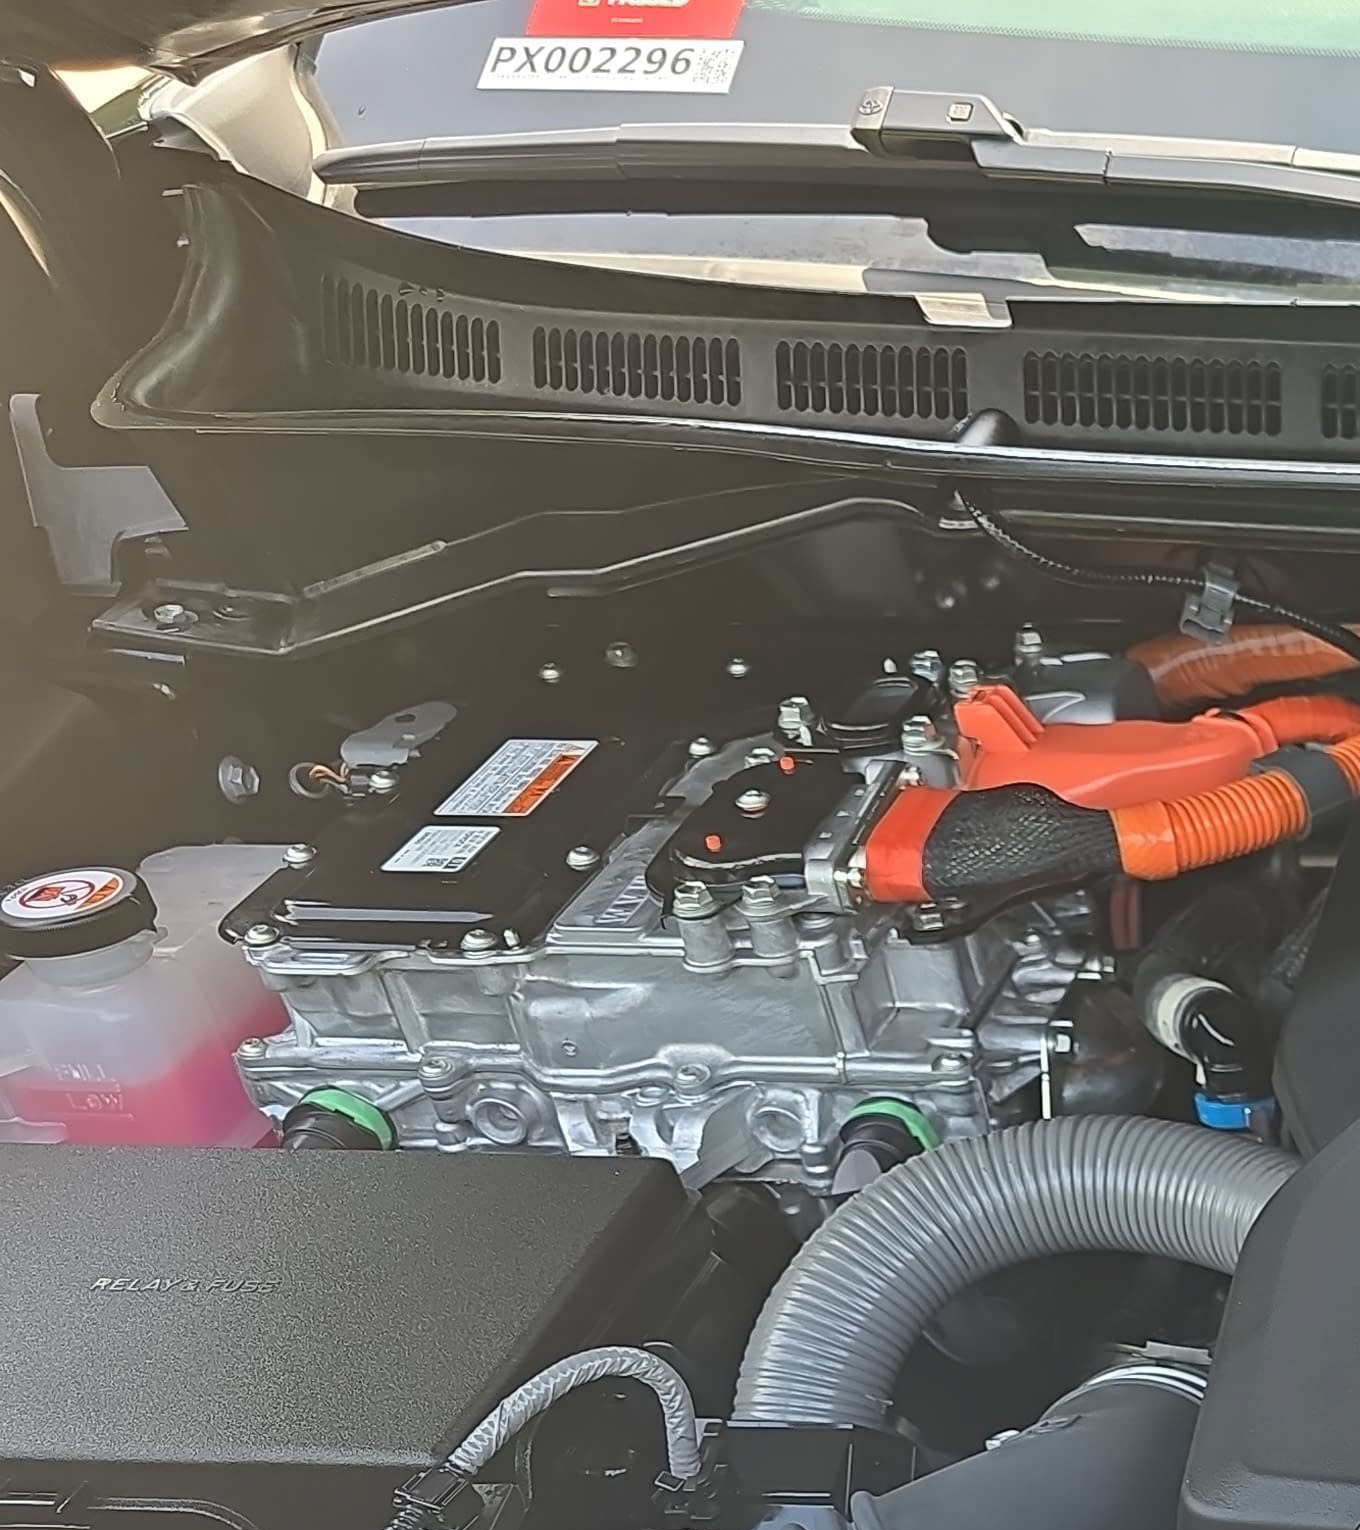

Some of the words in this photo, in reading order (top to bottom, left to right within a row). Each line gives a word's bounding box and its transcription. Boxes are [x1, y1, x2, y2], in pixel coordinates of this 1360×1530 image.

[490, 46, 695, 75] PX002296
[89, 1277, 184, 1291] RELAY
[206, 1278, 282, 1293] FUSE
